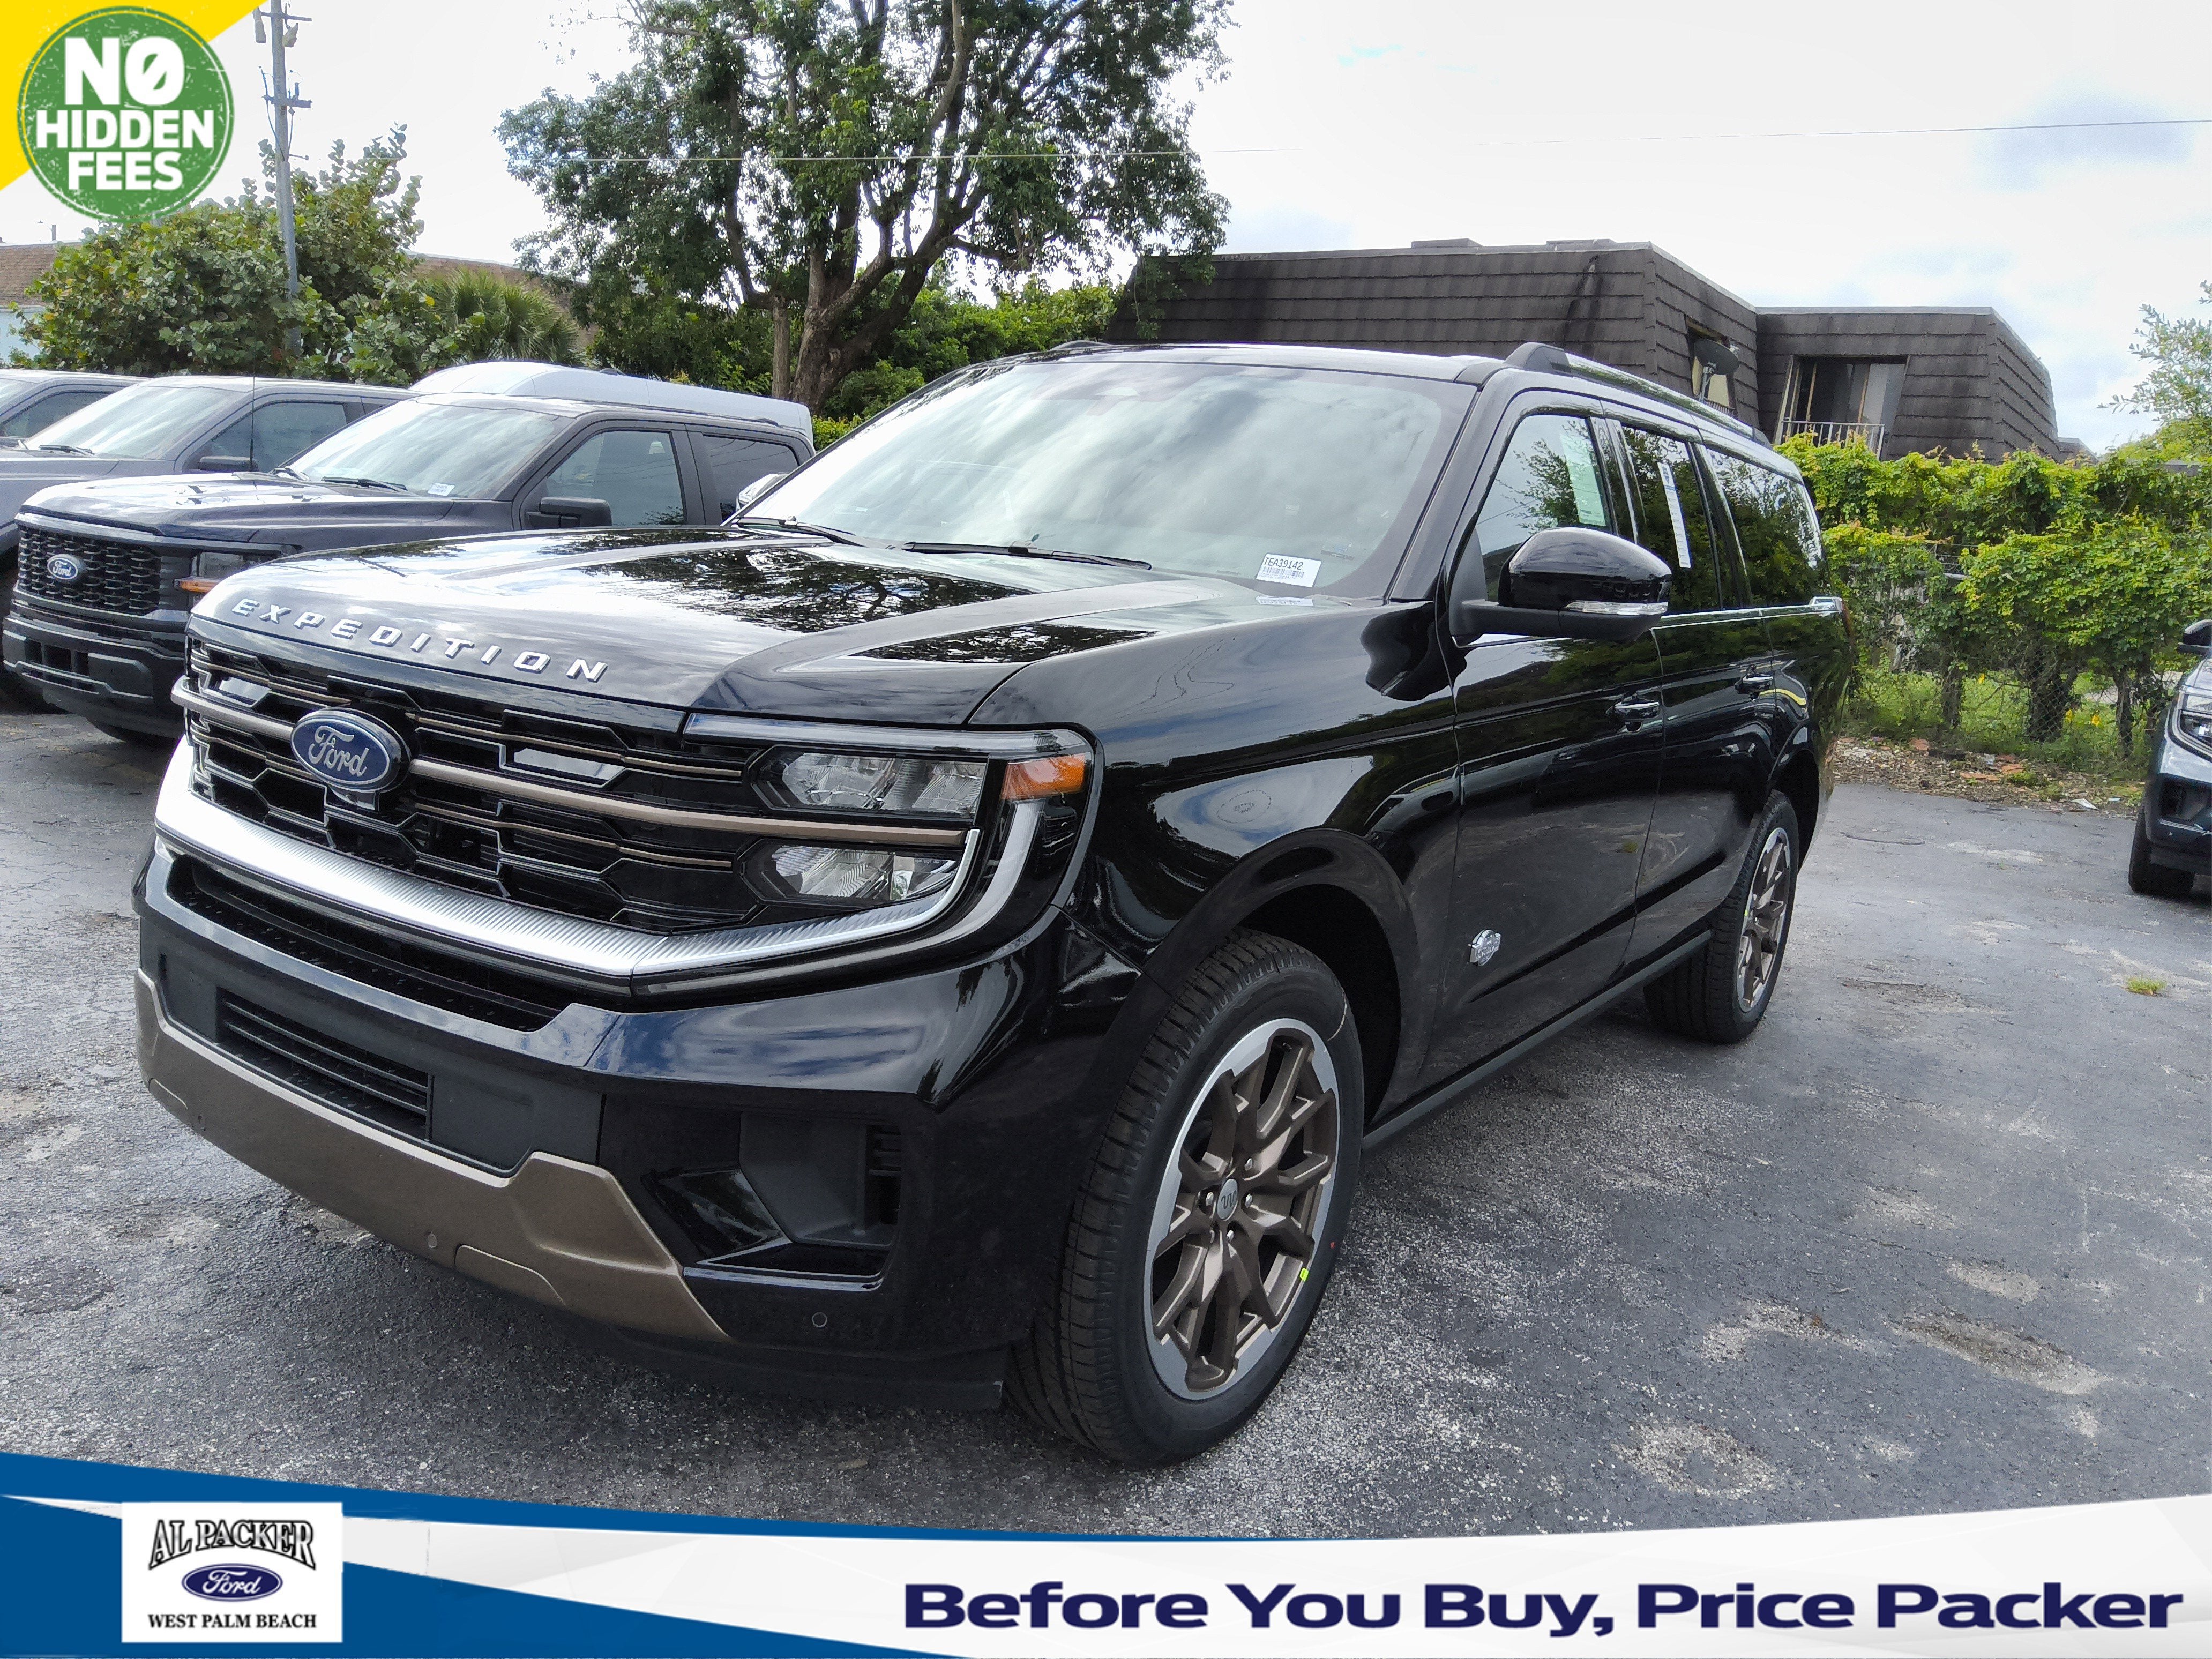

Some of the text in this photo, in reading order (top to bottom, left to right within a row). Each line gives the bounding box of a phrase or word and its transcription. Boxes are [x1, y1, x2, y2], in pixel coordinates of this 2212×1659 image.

[53, 560, 72, 577] Ford
[1264, 557, 1304, 570] TEA39142
[231, 598, 608, 682] EXPEDITION
[308, 725, 370, 778] Ford
